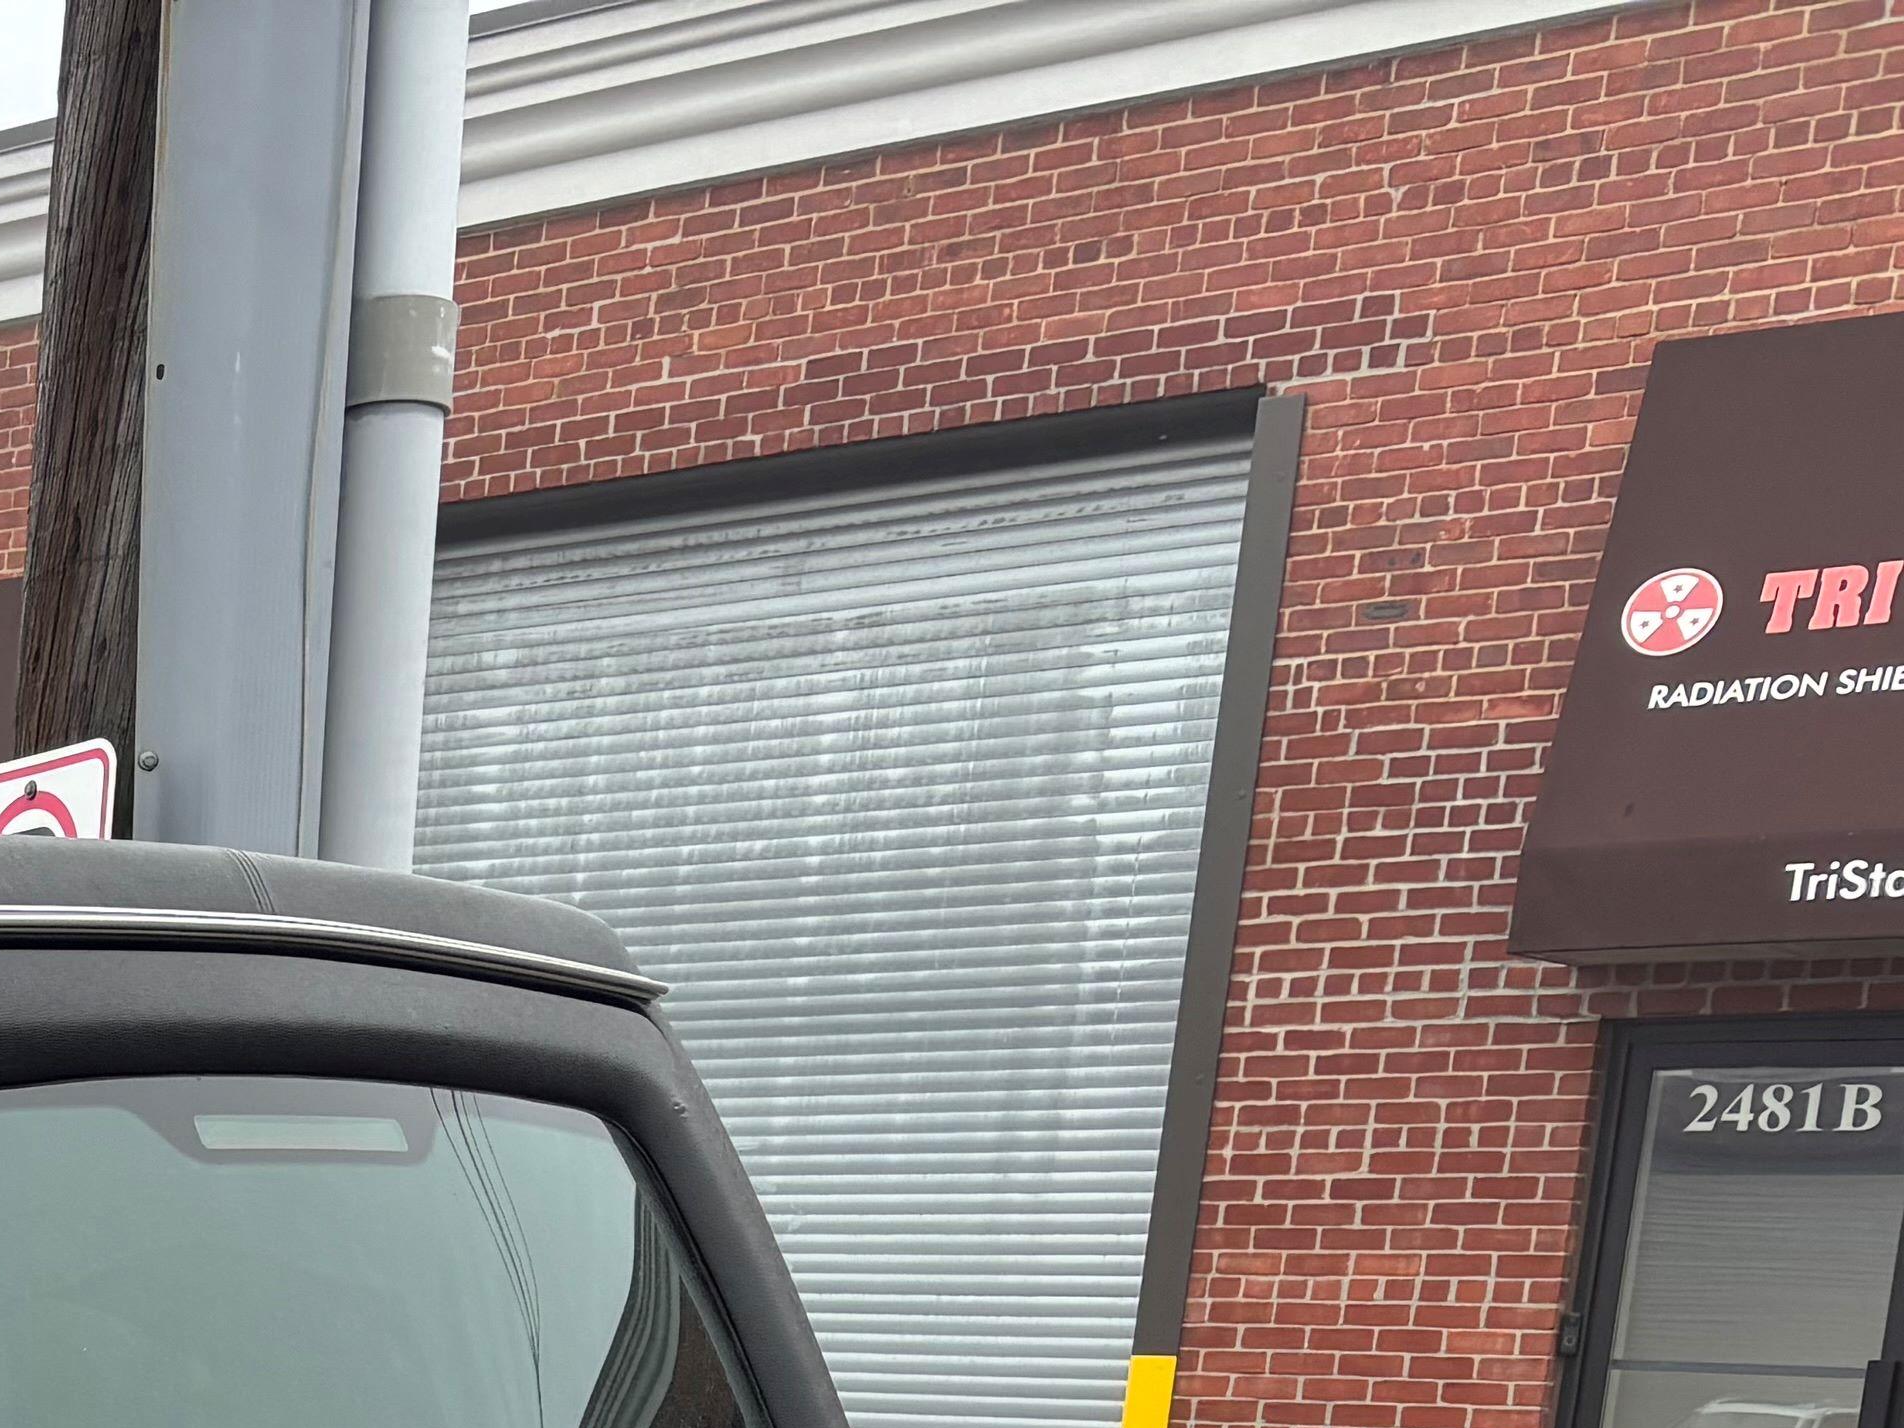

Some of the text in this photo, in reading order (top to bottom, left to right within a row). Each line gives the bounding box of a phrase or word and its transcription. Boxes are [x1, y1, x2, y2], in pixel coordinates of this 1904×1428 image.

[1760, 560, 1904, 634] TRI
[1648, 671, 1829, 710] RADIATION
[1682, 1082, 1884, 1132] 2481B
